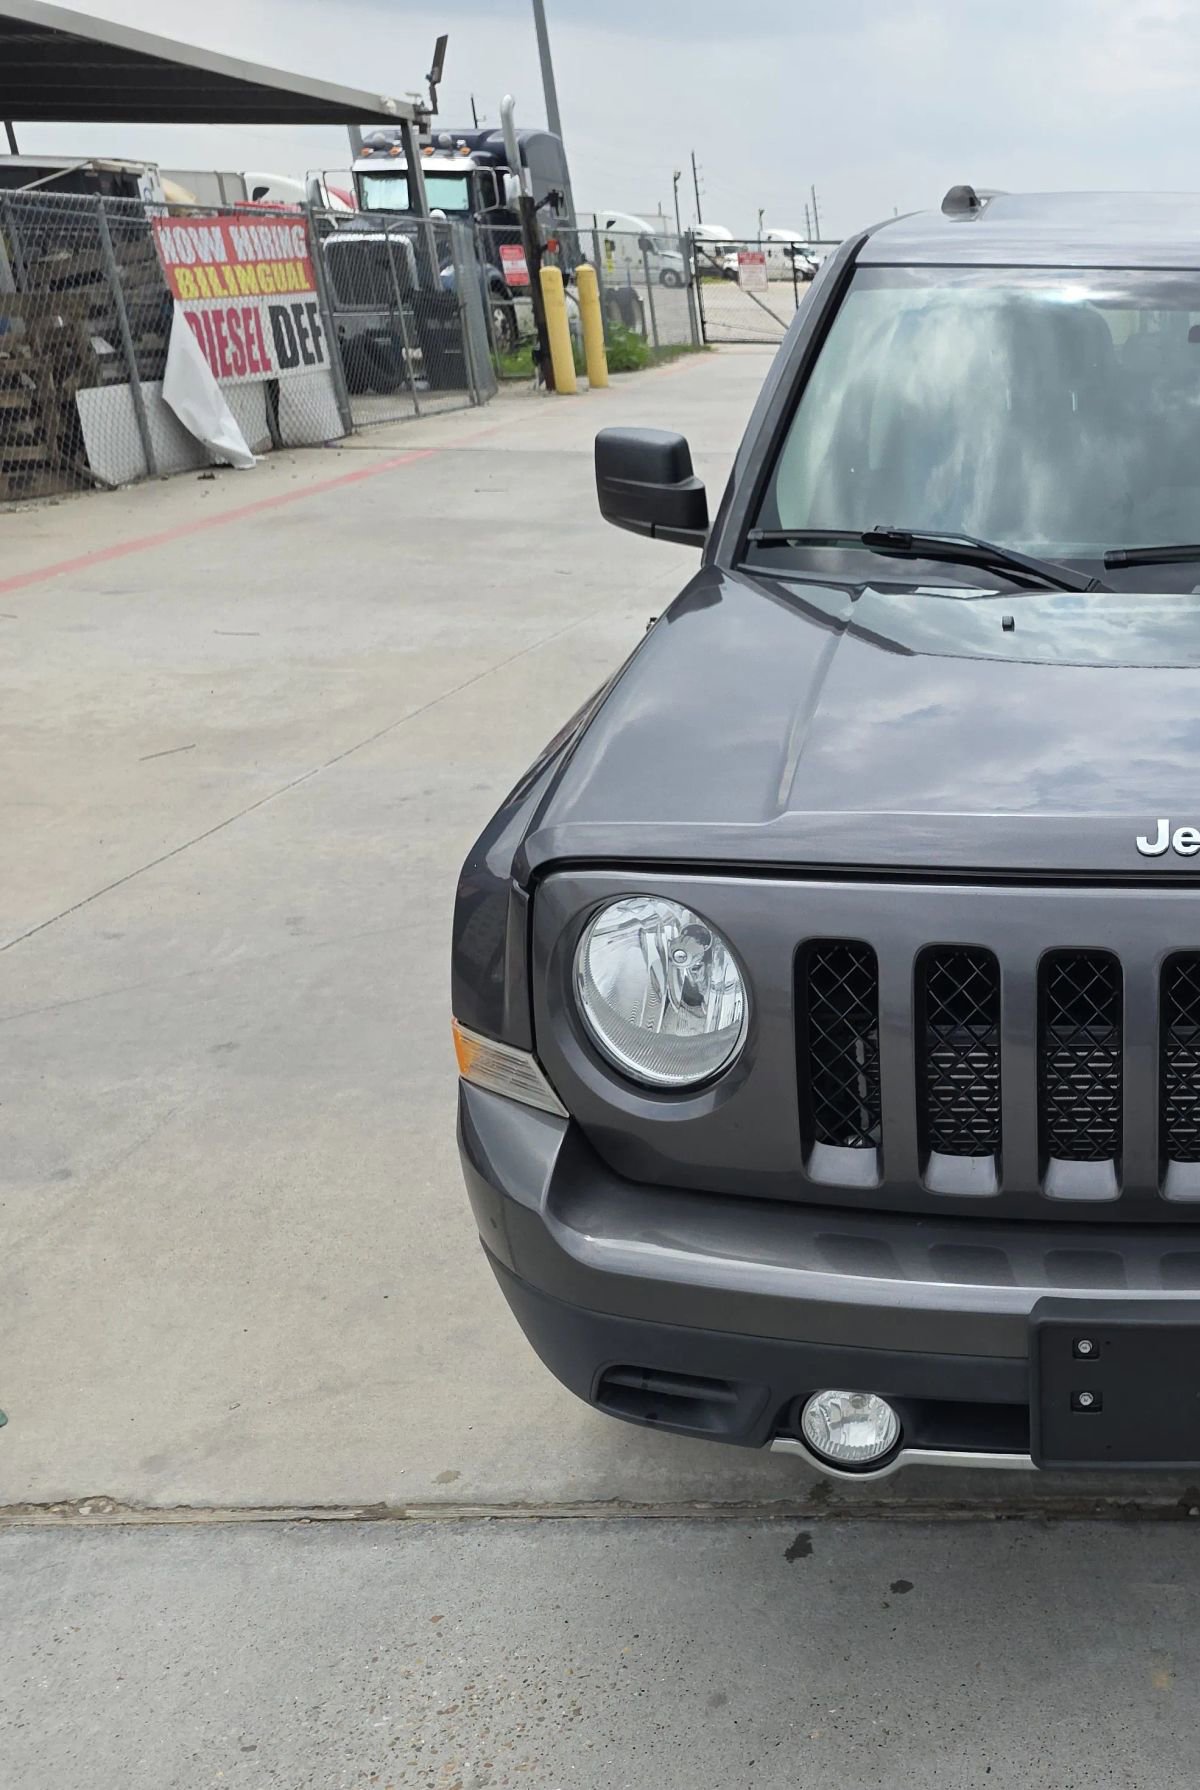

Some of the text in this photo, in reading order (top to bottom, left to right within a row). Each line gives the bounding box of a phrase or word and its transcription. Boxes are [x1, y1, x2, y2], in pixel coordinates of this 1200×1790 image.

[157, 225, 306, 264] NOW HIRING
[174, 262, 310, 299] BILINGUAL
[268, 302, 326, 370] DEF
